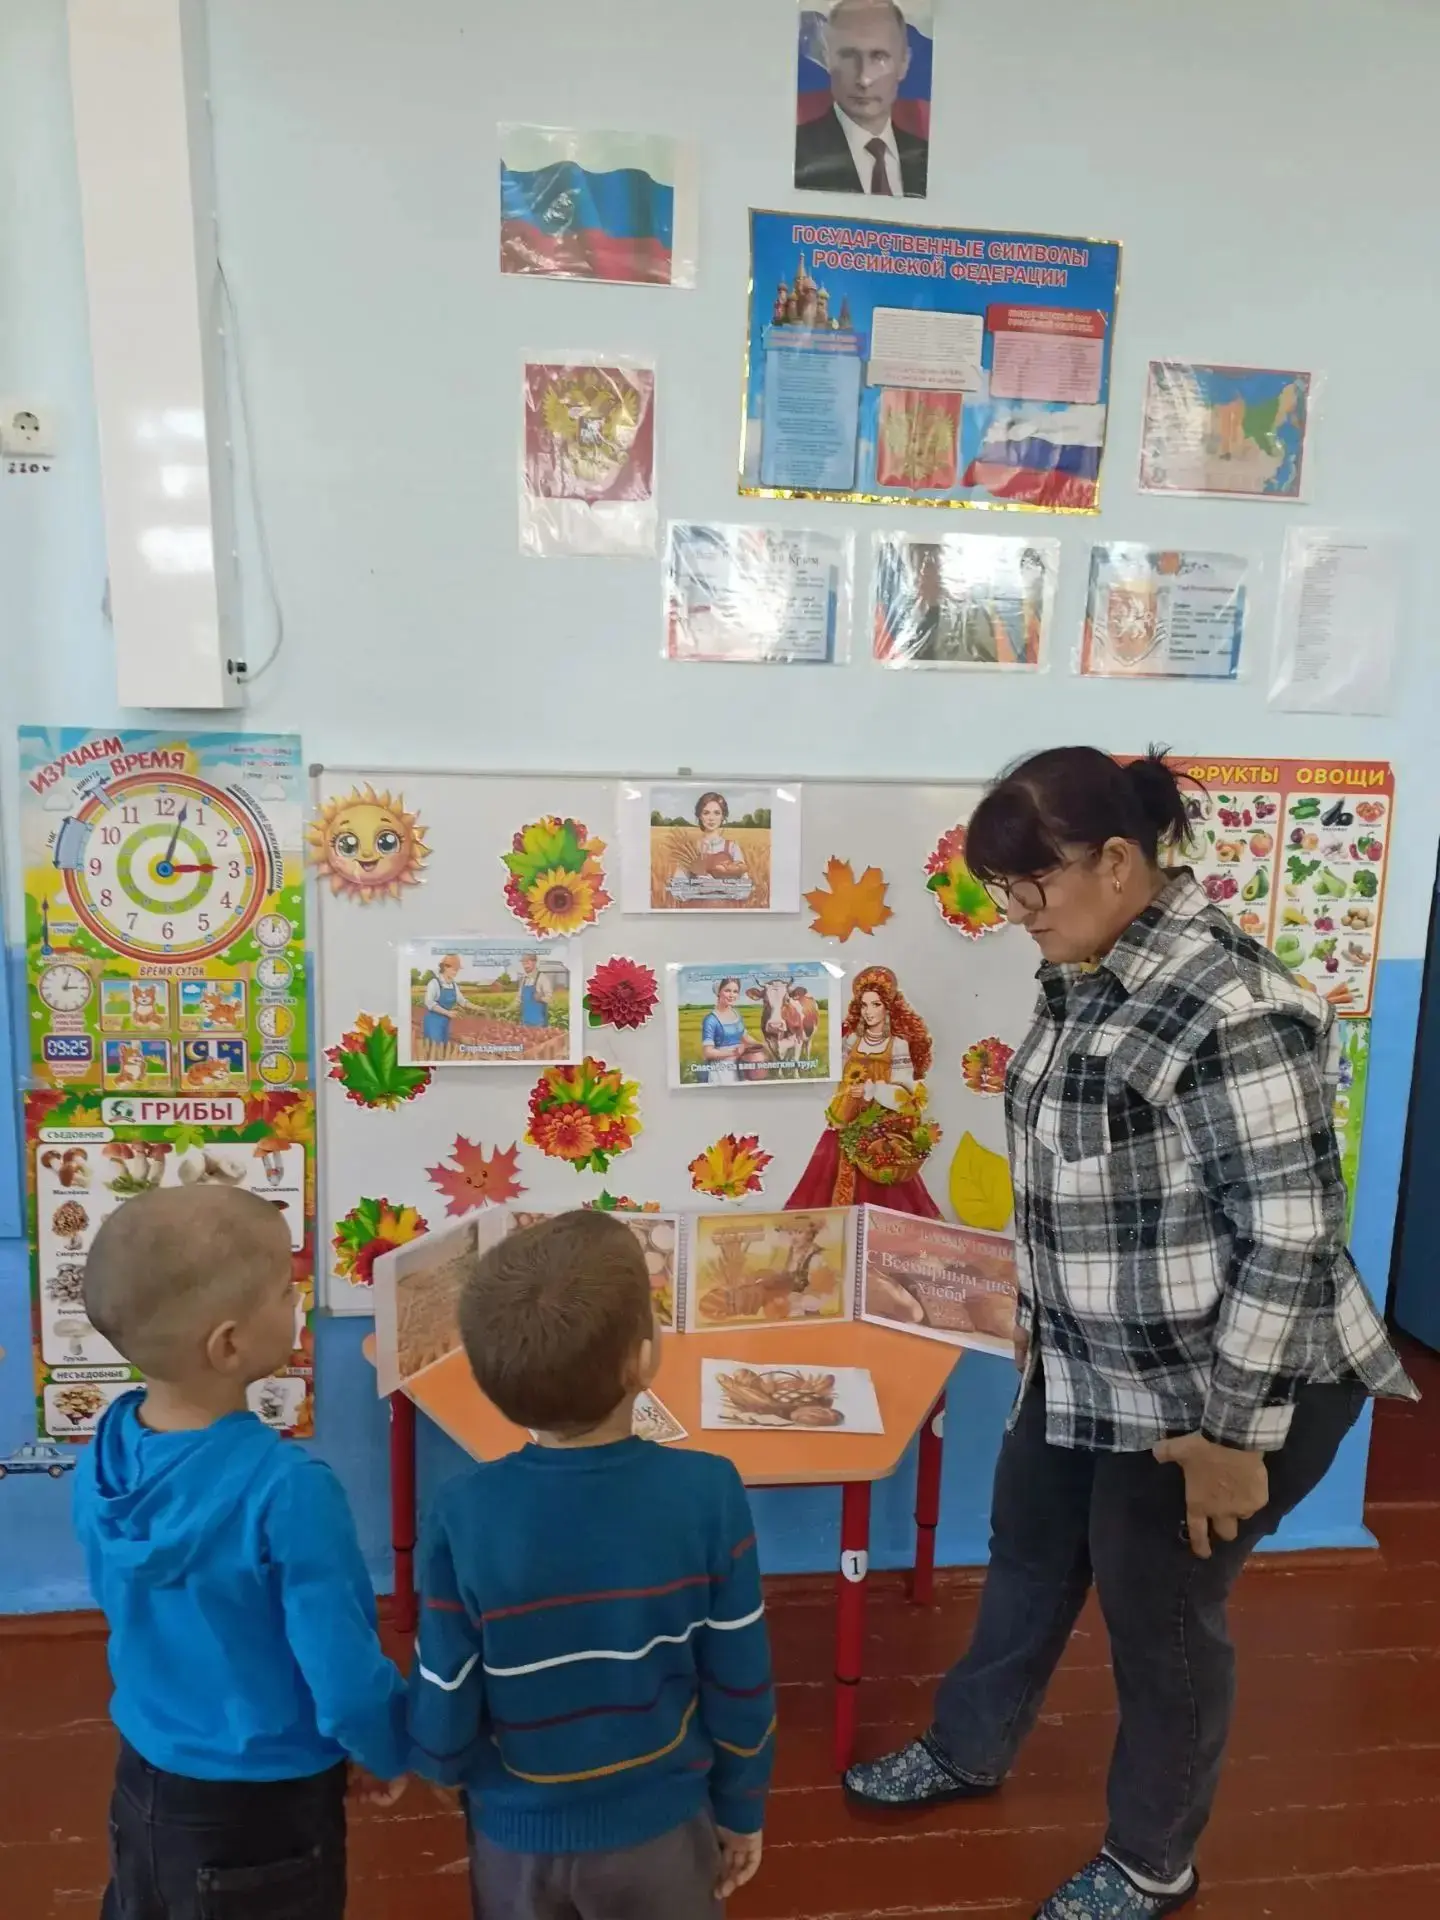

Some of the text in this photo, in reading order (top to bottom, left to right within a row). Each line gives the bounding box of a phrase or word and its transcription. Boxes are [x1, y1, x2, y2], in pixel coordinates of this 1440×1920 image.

[792, 224, 1088, 267] ГОСУДАРСТВЕННЫЕ СИМВОЛЫ
[812, 249, 1068, 288] РОССИЙСКОЙ ФЕДЕРАЦИИ
[28, 736, 125, 795] ИЗУЧАЕМ
[109, 751, 186, 777] ВРЕМЯ
[1187, 765, 1386, 788] ФРУКТЫ ОВОЩИ
[121, 807, 141, 824] 11
[154, 798, 176, 816] 12
[196, 808, 206, 826] 1
[101, 826, 121, 845] 10
[216, 829, 228, 847] 2
[89, 858, 102, 876] 9
[228, 861, 240, 879] 3
[100, 888, 113, 907] 8
[220, 892, 232, 909] 4
[126, 912, 138, 930] 7
[198, 914, 210, 931] 5
[161, 922, 174, 940] 6
[47, 1039, 89, 1056] 09:25
[141, 1102, 233, 1121] ГРИБЫ
[56, 1370, 124, 1379] НЕСЪЕДОБНЫЕ
[851, 1557, 859, 1575] 1
